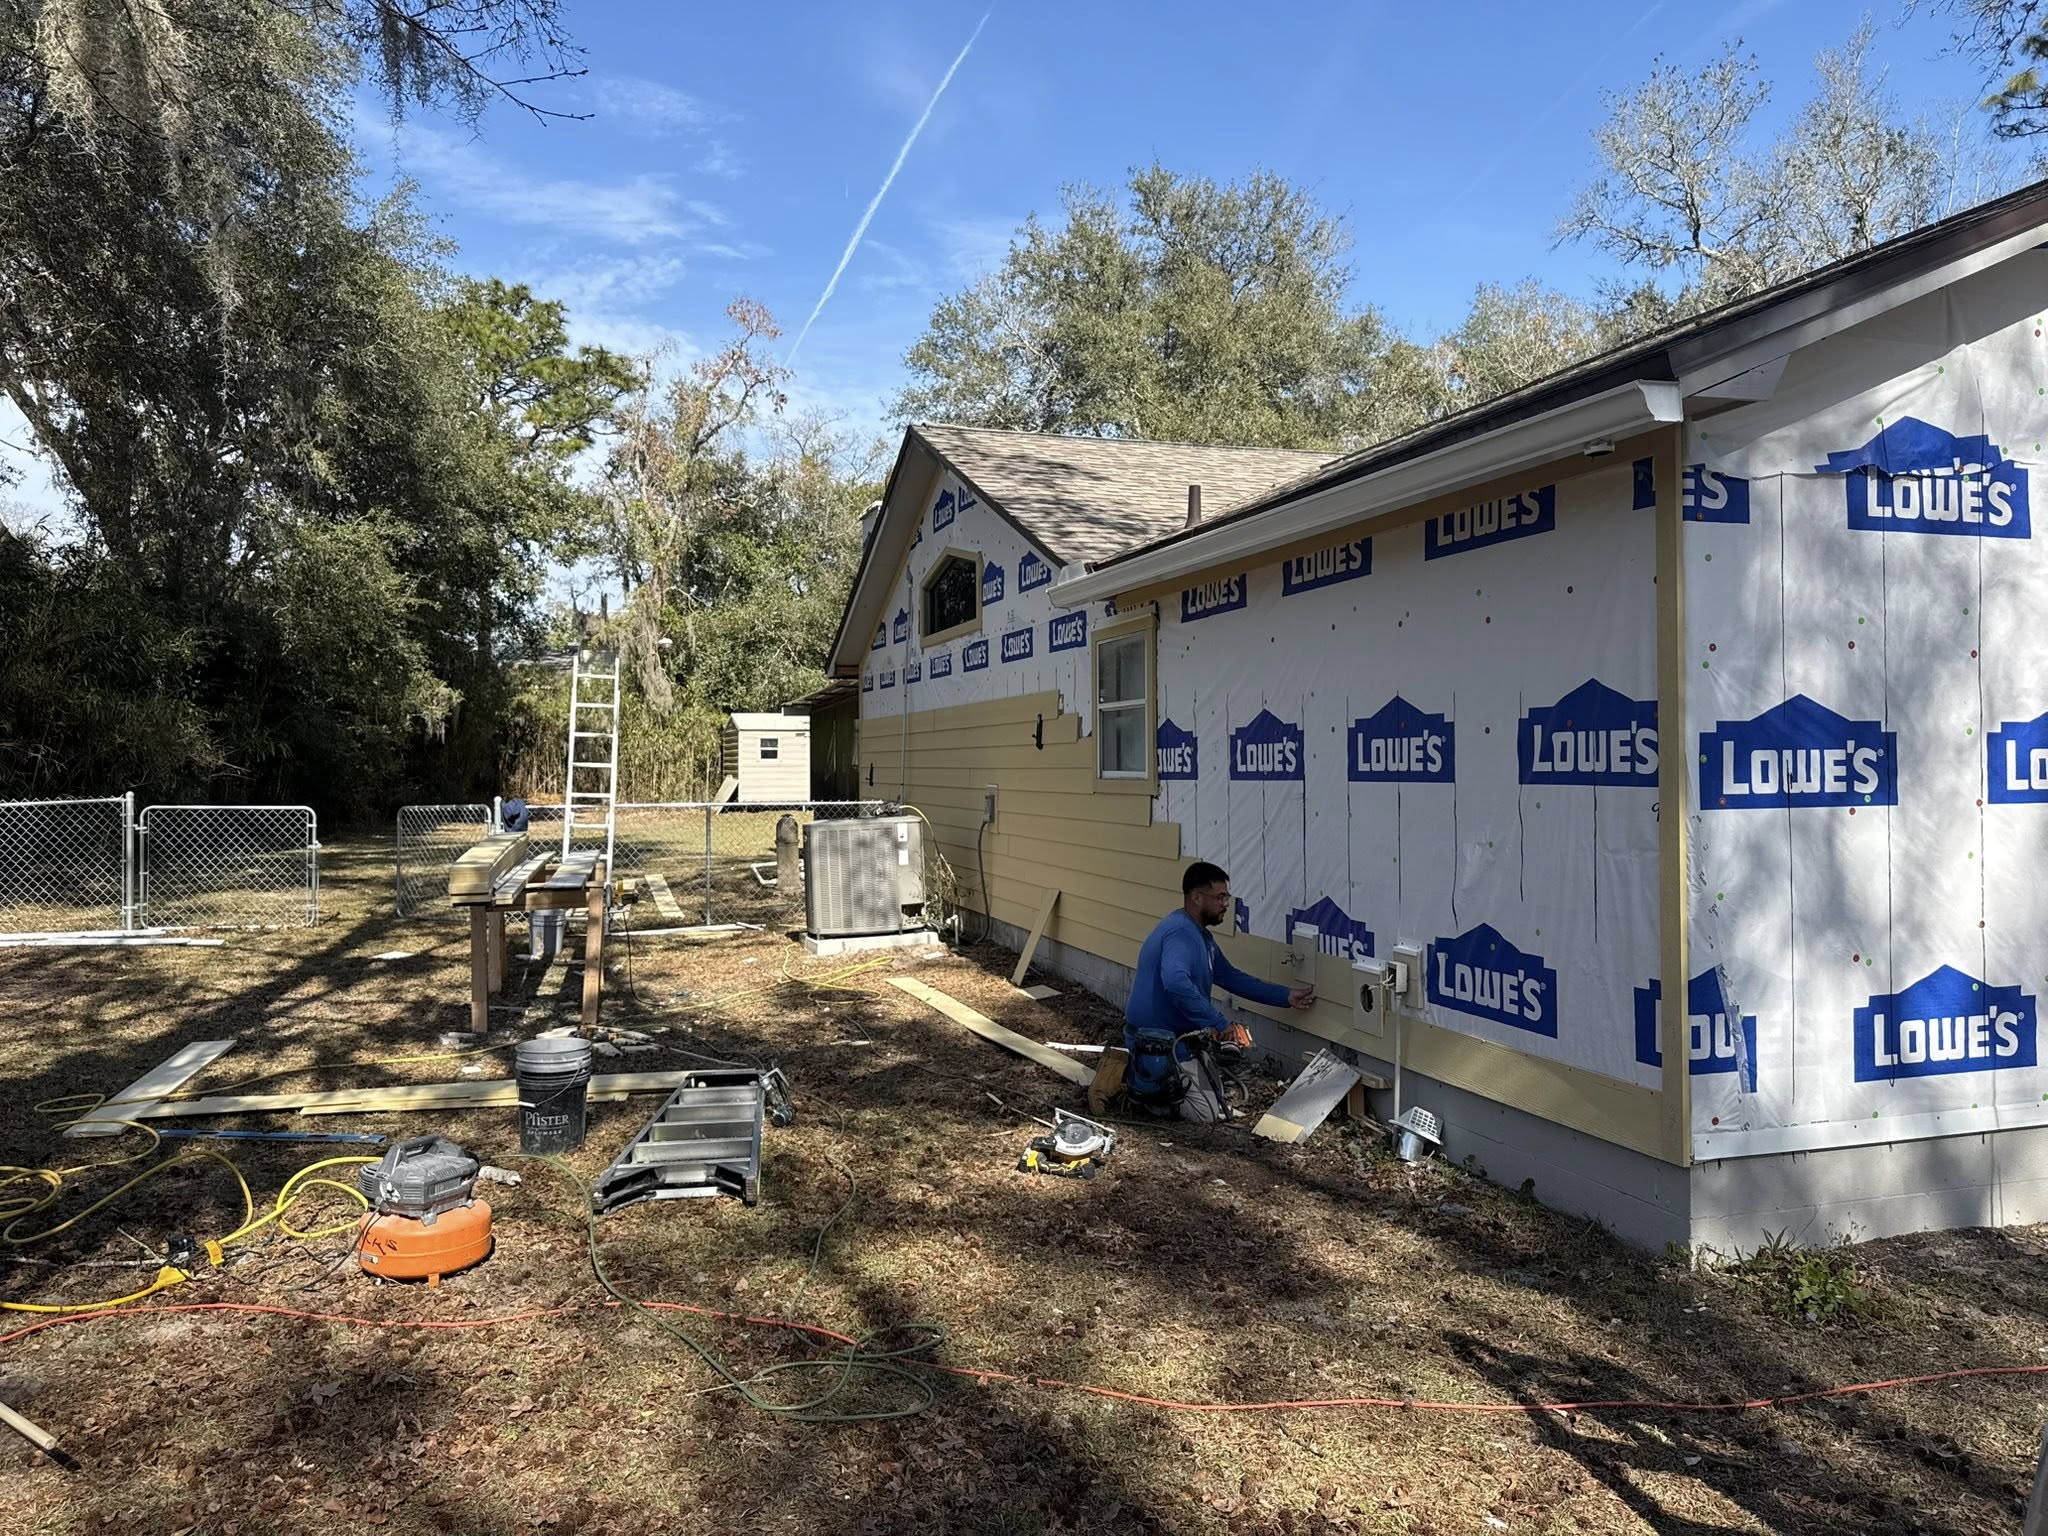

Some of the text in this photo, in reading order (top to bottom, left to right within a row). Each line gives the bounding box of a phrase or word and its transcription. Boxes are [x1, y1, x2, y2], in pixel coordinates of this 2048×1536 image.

[1867, 466, 2012, 527] LOWE'S
[1004, 630, 1030, 657] LOWE'S
[1052, 617, 1083, 646] LOWE'S
[1237, 736, 1297, 773] LOWE'S
[1357, 729, 1443, 773] LOWE'S
[1532, 720, 1658, 775] LOWE'S
[1722, 740, 1879, 796] LOWE'S
[1436, 951, 1543, 1022] LOWE'S
[1873, 1005, 2020, 1067] LOWE'S
